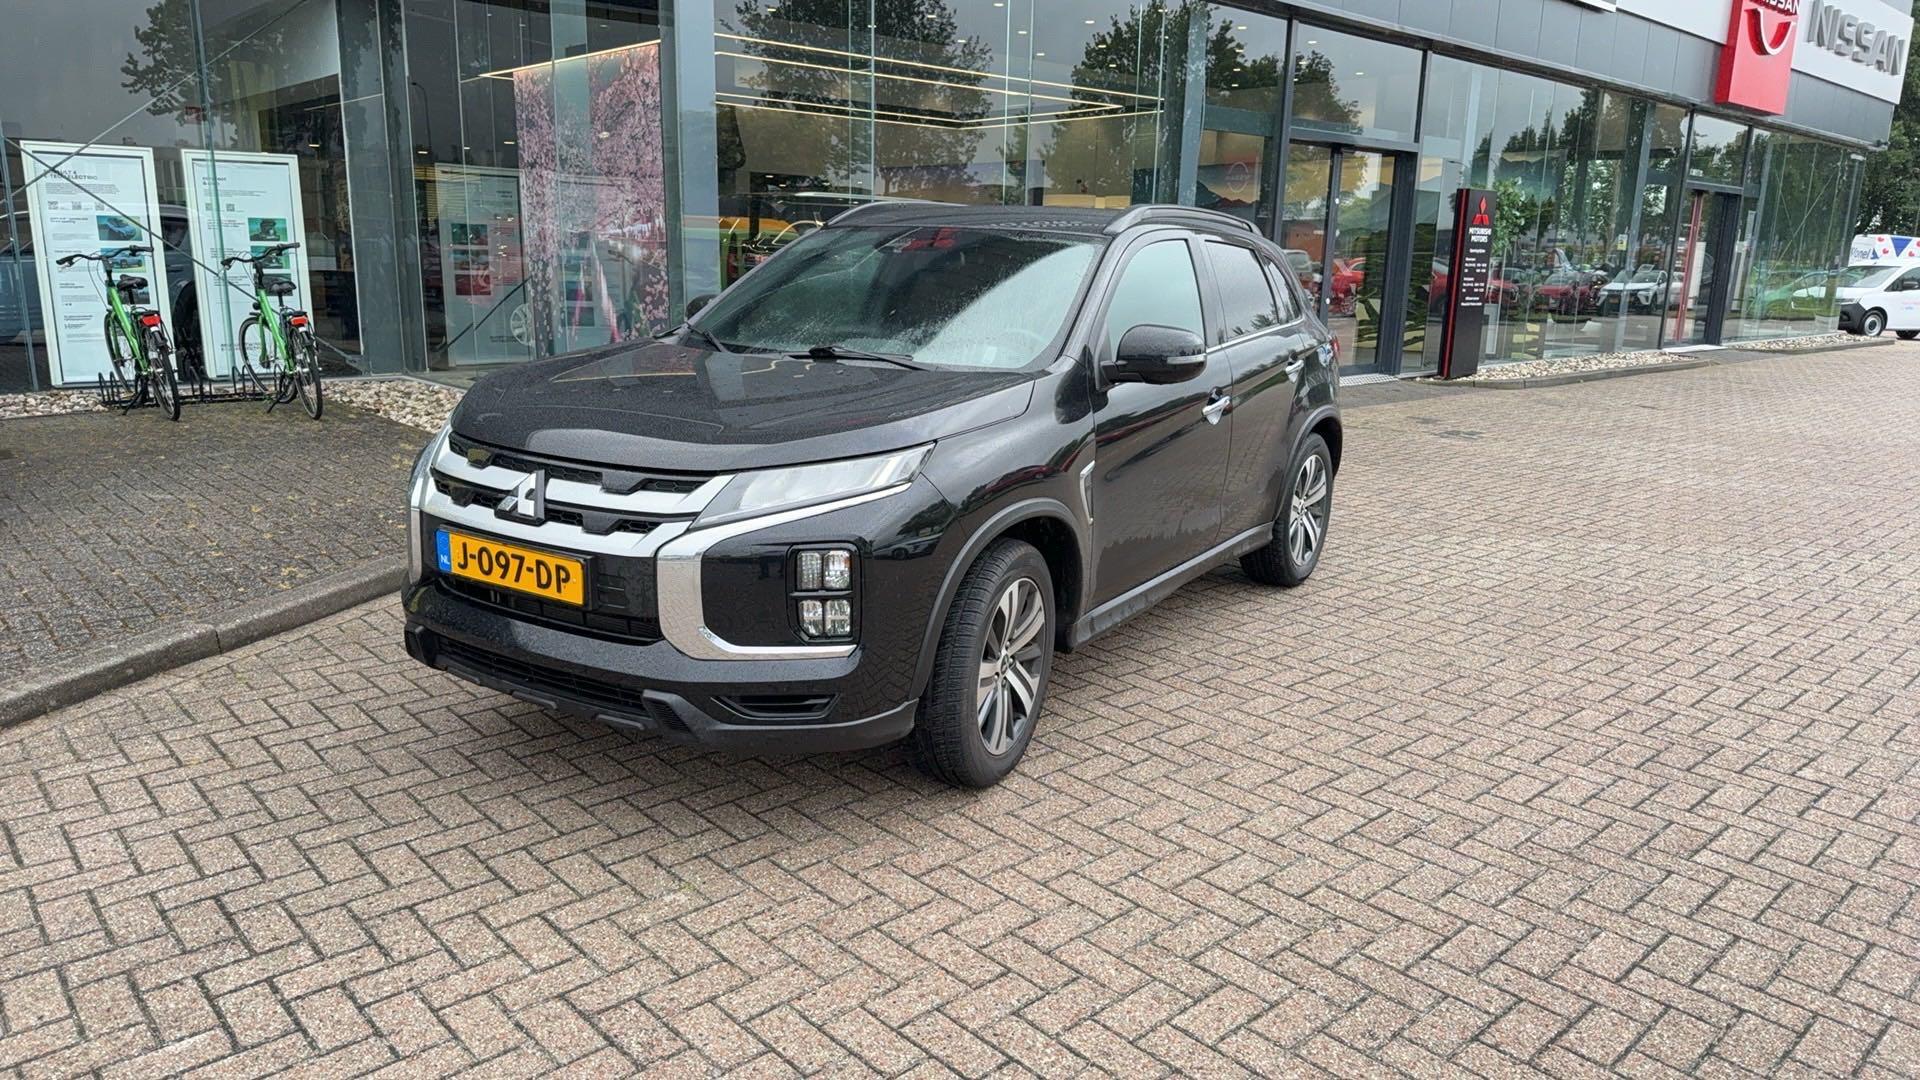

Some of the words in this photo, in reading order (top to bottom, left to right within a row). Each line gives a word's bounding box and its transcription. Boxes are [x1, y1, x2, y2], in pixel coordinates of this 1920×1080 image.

[1807, 0, 1905, 75] NISSAN
[440, 554, 450, 565] NL
[457, 541, 571, 594] J-097-DP
